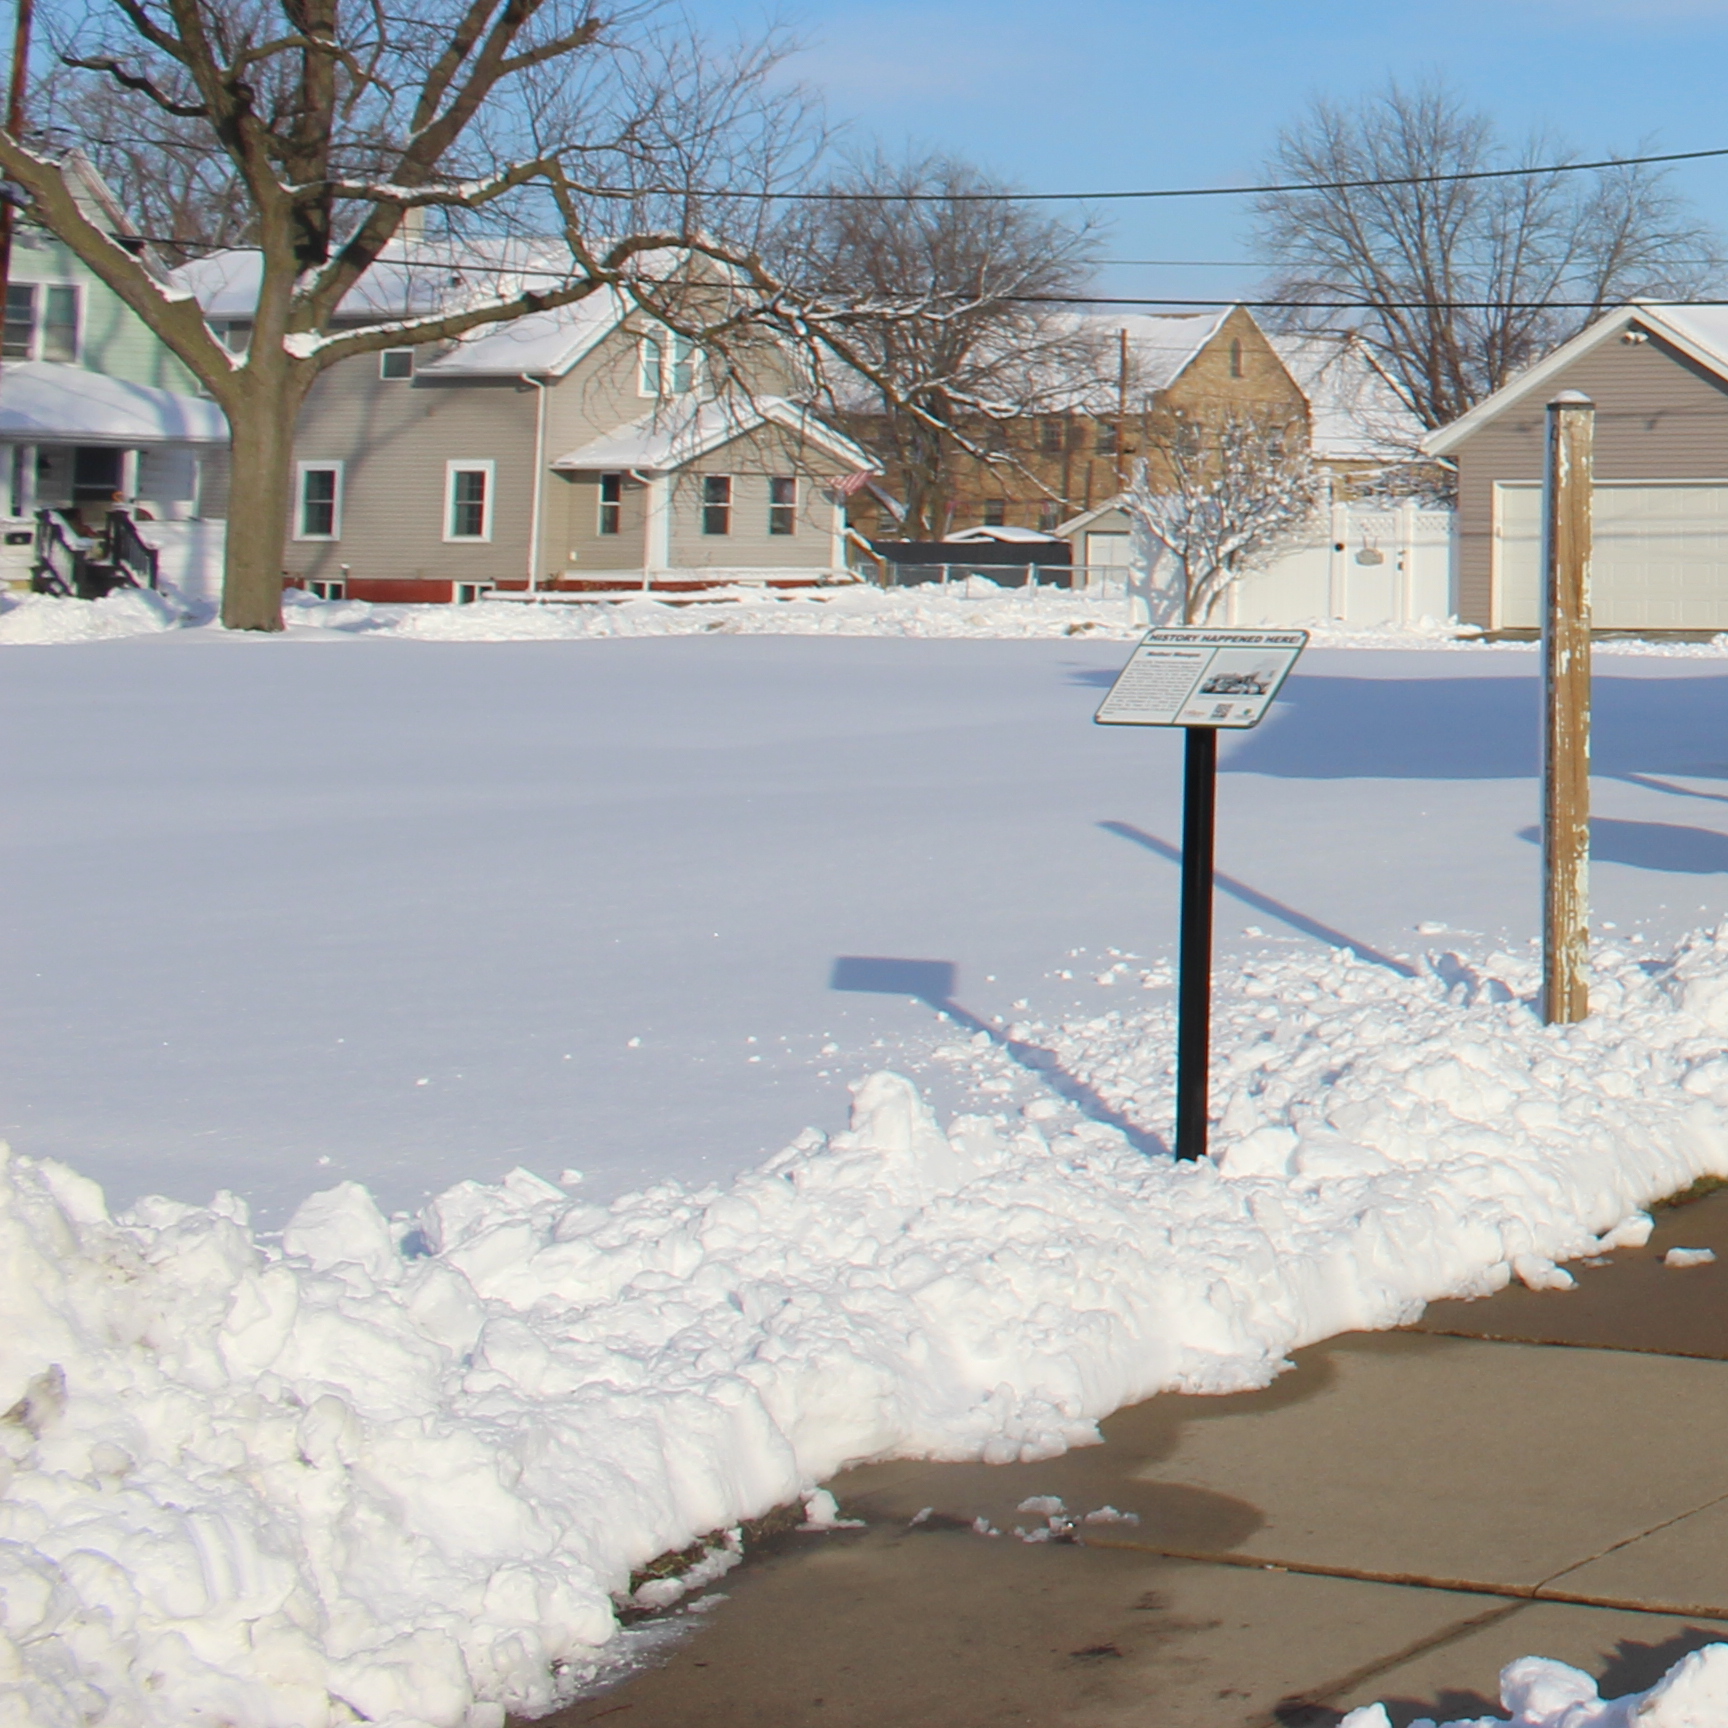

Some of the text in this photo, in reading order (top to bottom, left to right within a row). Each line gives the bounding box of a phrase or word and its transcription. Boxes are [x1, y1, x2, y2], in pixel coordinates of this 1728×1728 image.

[1149, 633, 1300, 644] HISTORY HAPPENED HERE!
